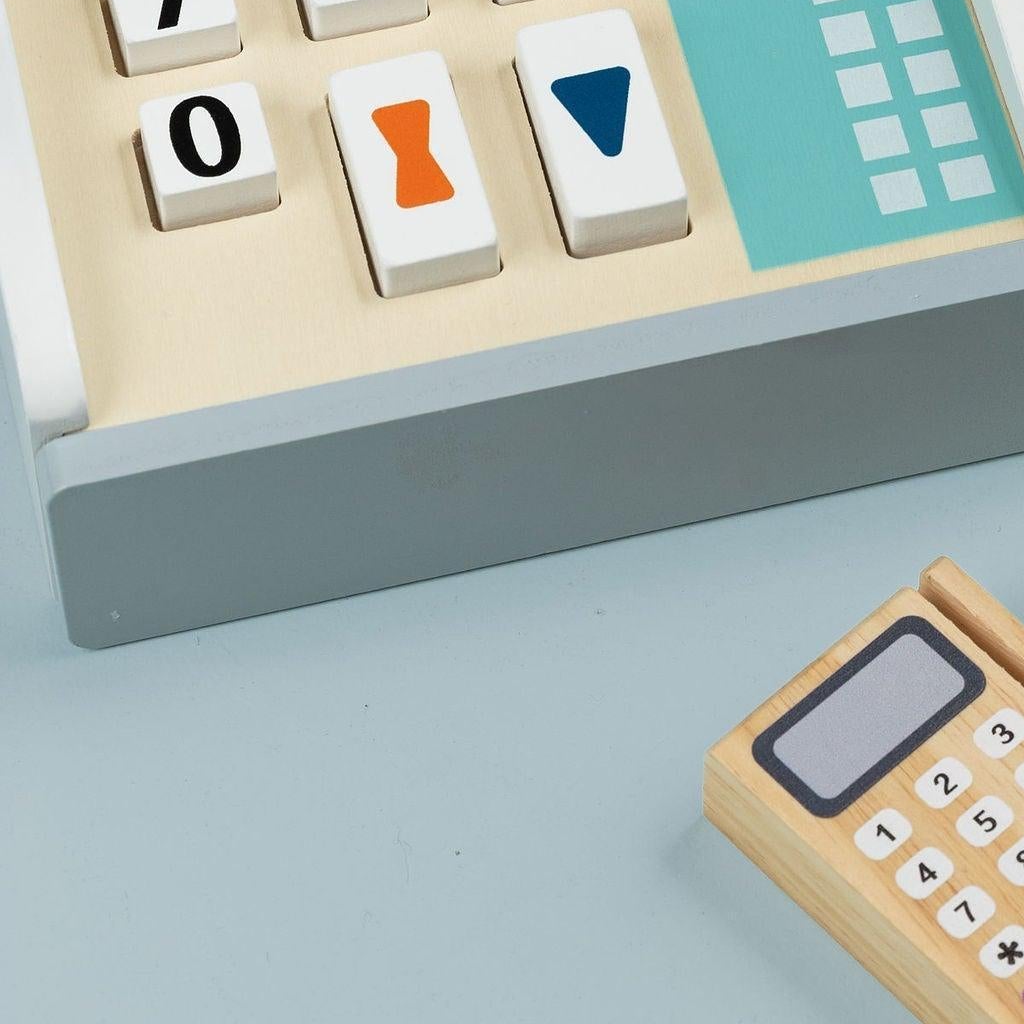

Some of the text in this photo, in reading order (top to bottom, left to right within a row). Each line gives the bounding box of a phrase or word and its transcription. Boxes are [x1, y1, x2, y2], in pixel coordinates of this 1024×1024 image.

[169, 95, 242, 178] 0
[991, 723, 1015, 745] 3
[933, 773, 958, 796] 2
[973, 809, 998, 833] 5
[876, 823, 896, 843] 1
[918, 862, 938, 883] 4
[954, 900, 977, 923] 7
